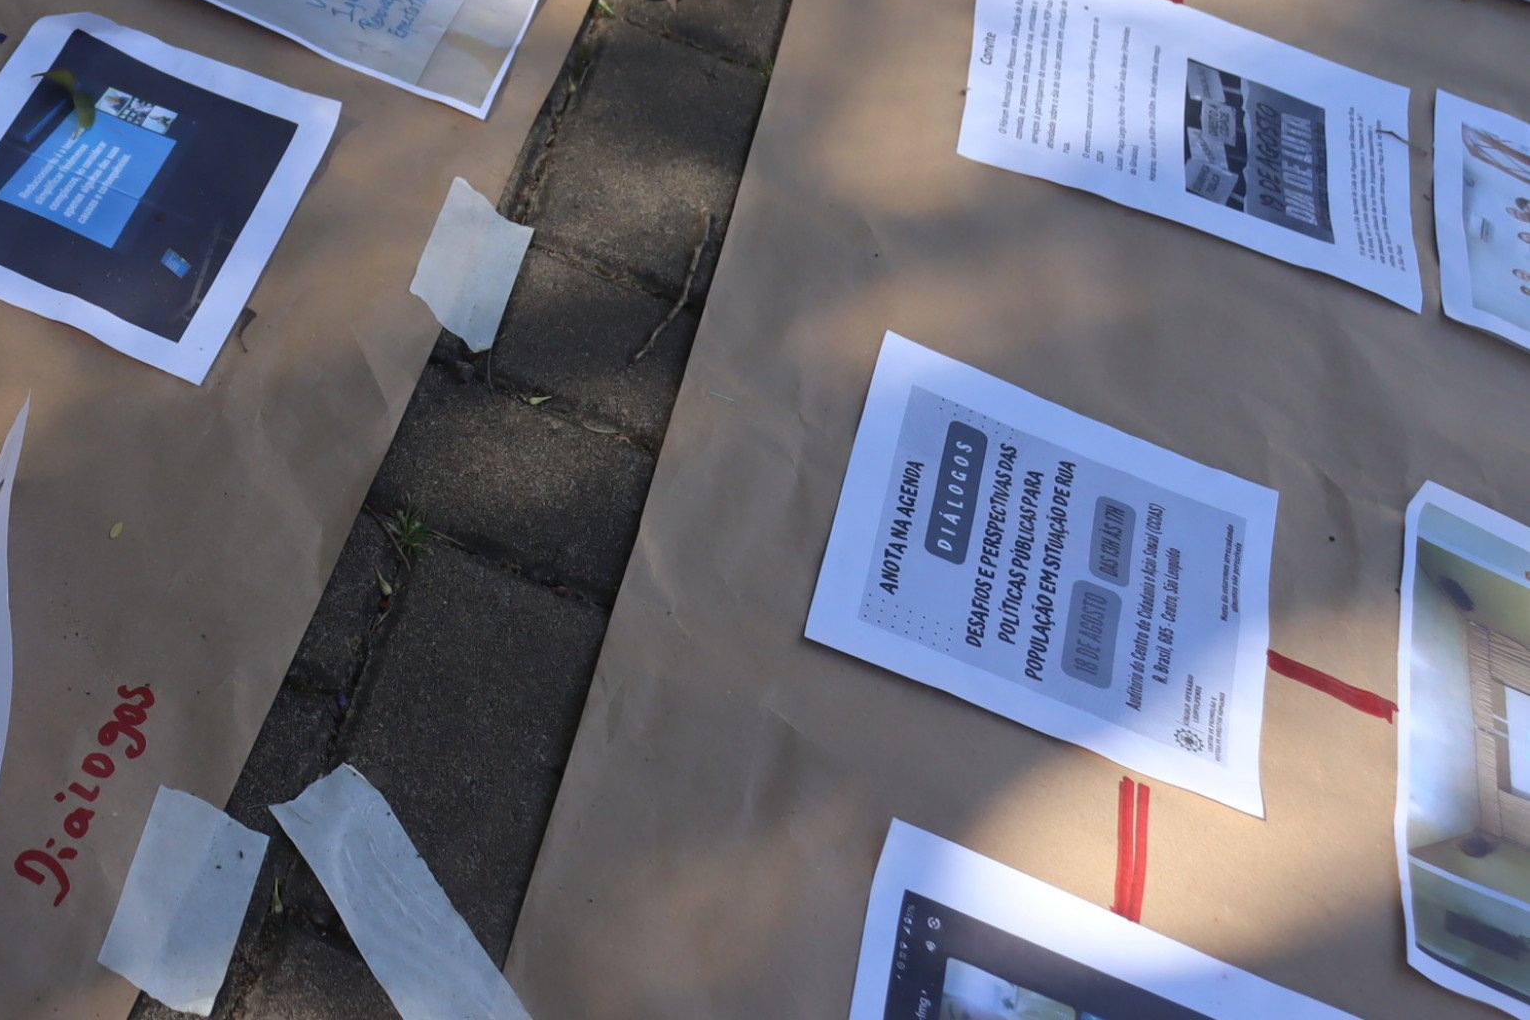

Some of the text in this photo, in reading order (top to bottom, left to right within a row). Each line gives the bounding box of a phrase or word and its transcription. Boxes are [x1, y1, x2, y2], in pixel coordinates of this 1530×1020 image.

[979, 31, 996, 65] Convite
[937, 441, 972, 551] DIÁLOGOS
[879, 461, 924, 595] ANOTA NA AGENDA
[1104, 504, 1125, 524] 17H
[965, 443, 1017, 648] DESAFIOS E PERSPECTIVAS DAS
[998, 471, 1044, 645] POLÍTICAS PÚBLICAS PARA
[1100, 539, 1121, 556] 13H
[1142, 533, 1160, 558] Social
[1025, 461, 1076, 681] POPULAÇÃO EM SITUAÇÃO DE RUA
[1098, 555, 1119, 578] DAS
[1141, 558, 1159, 577] Ação
[1164, 547, 1183, 580] Leopoldo
[1137, 582, 1155, 620] Cidadania
[1163, 579, 1179, 594] São
[1160, 595, 1179, 622] Centro,
[1073, 591, 1107, 676] 18 DE AGOSTO
[1134, 619, 1150, 630] de
[1130, 632, 1149, 662] Centro
[1153, 645, 1174, 674] Brasil,
[1129, 661, 1145, 674] do
[1152, 674, 1168, 685] R.
[1125, 673, 1144, 711] Auditório
[14, 684, 155, 907] Diálogos
